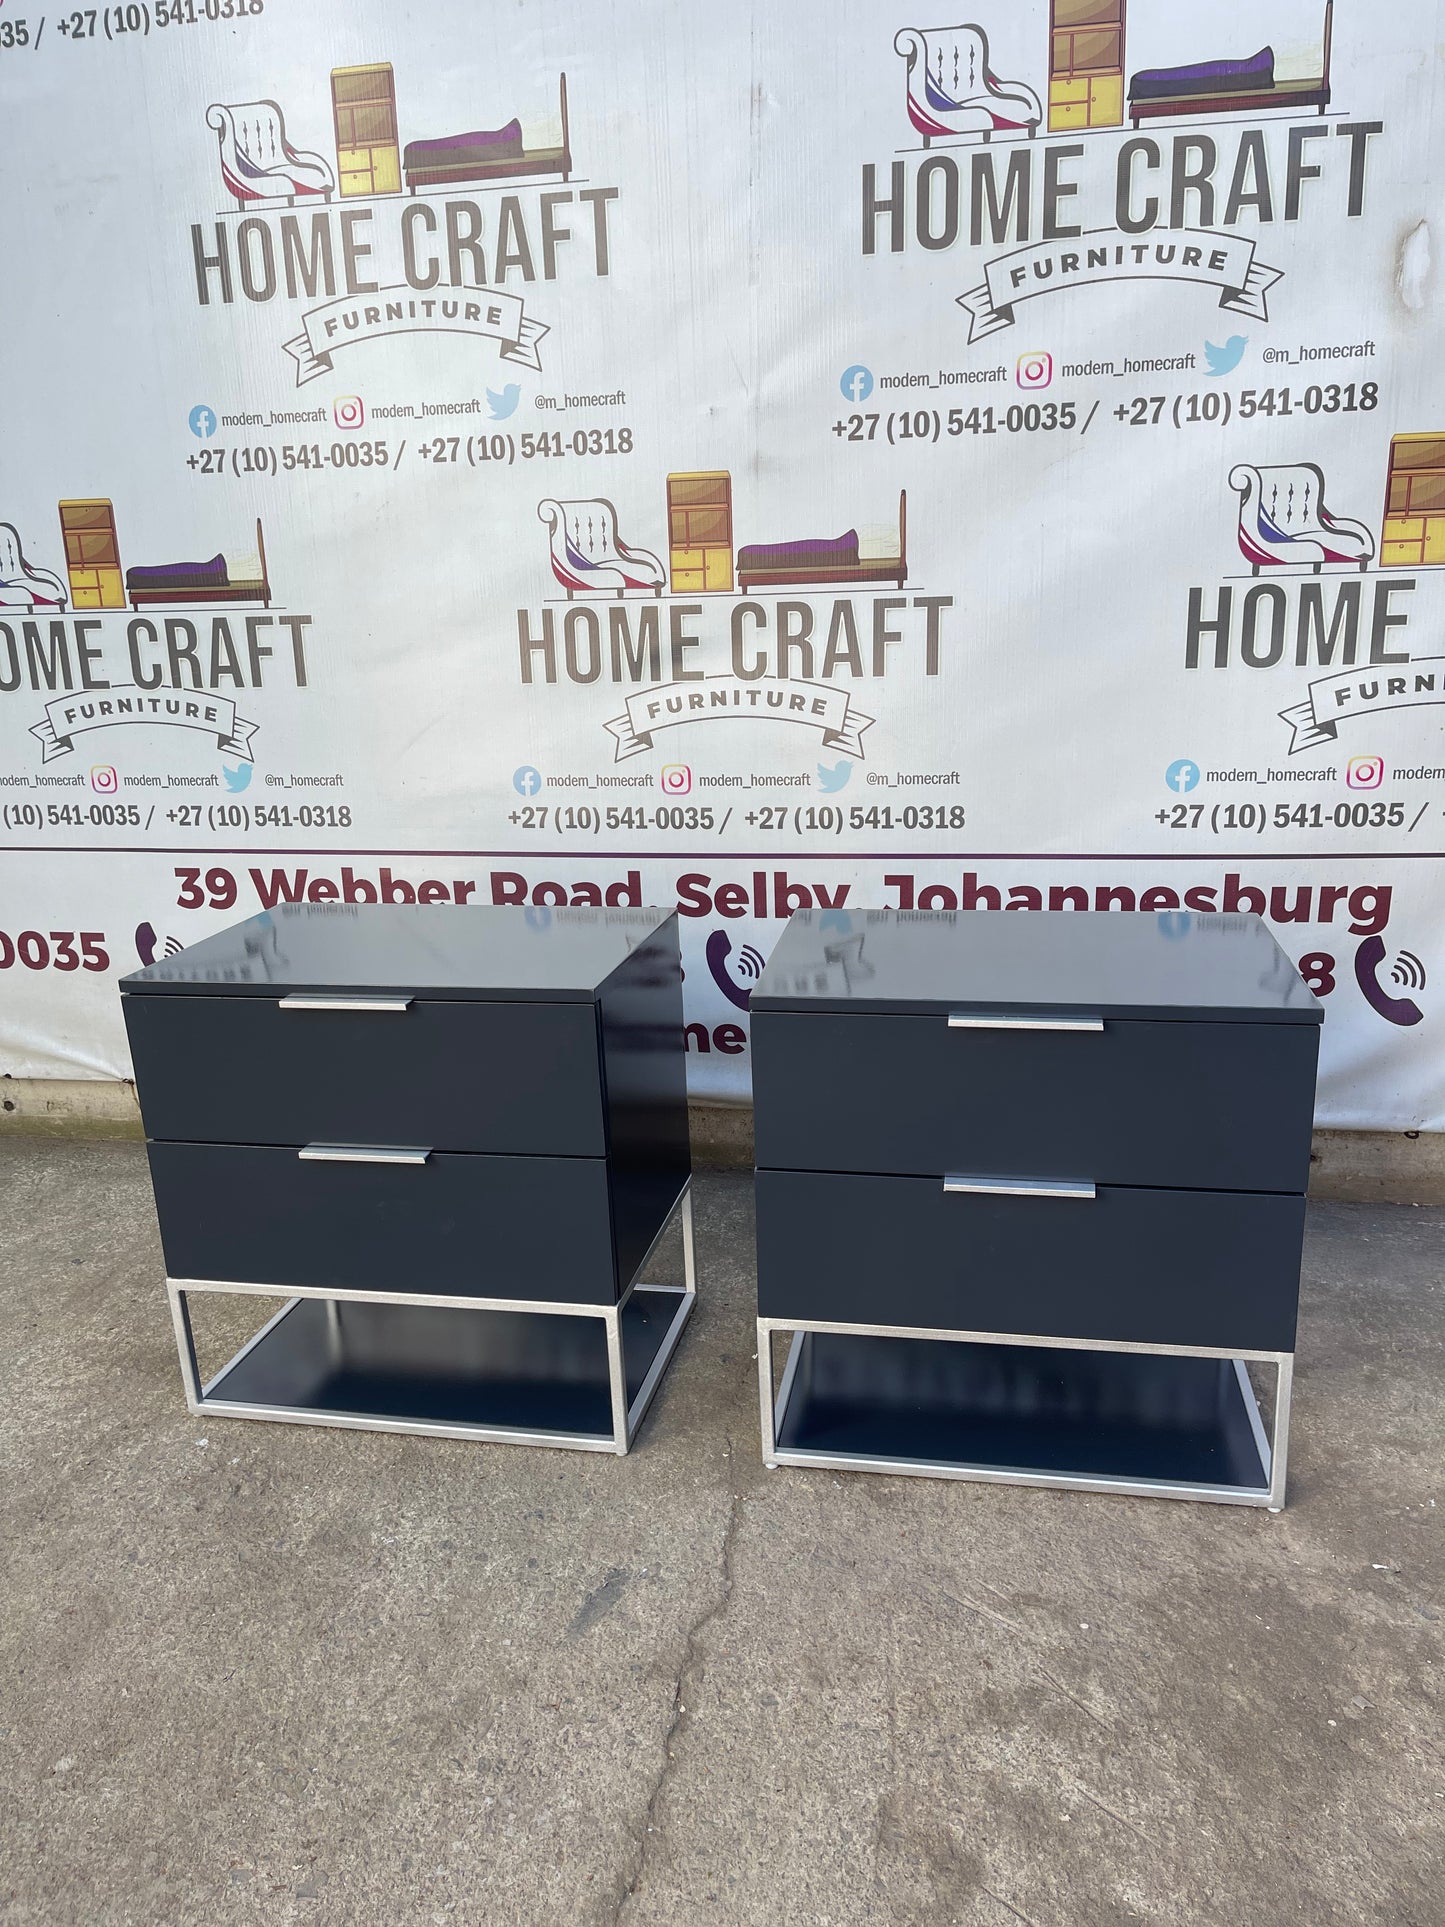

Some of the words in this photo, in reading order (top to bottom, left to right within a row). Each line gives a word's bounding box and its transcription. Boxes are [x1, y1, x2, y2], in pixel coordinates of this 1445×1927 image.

[34, 17, 45, 50] /
[57, 10, 97, 39] +27
[103, 3, 150, 40] (10)
[862, 144, 1084, 255] HOME
[1115, 121, 1383, 234] CRAFT
[190, 208, 379, 306] HOME
[400, 186, 619, 291] CRAFT
[1009, 244, 1229, 289] FURNITURE
[323, 299, 502, 338] FURNITURE
[1262, 341, 1375, 365] @m_homecraft
[534, 390, 626, 411] @m_homecraft
[832, 414, 880, 441] +27
[886, 410, 941, 445] (10)
[947, 402, 1076, 436] 541-0035
[1080, 400, 1100, 434] /
[1113, 397, 1166, 425] +27
[1172, 392, 1231, 429] (10)
[1238, 382, 1379, 419] 541-0318
[186, 448, 226, 474] +27
[232, 446, 277, 477] (10)
[282, 441, 389, 470] 541-0035
[393, 440, 406, 470] /
[418, 437, 460, 463] +27
[467, 434, 515, 466] (10)
[521, 427, 634, 459] 541-0318
[516, 604, 705, 684] HOME
[730, 596, 954, 681] CRAFT
[1185, 579, 1416, 669] HOME
[127, 615, 313, 691] CRAFT
[64, 697, 218, 724] FURNITURE
[647, 689, 828, 719] FURNITURE
[265, 774, 344, 788] @m_homecraft
[866, 771, 960, 787] @m_homecraft
[3, 804, 43, 830] (10)
[47, 804, 140, 826] 541-0035
[145, 805, 155, 830] /
[166, 805, 202, 826] +27
[208, 805, 250, 831] (10)
[254, 804, 352, 827] 541-0318
[508, 806, 549, 829] +27
[554, 806, 600, 834] (10)
[606, 806, 714, 830] 541-0035
[718, 807, 733, 835] /
[745, 807, 788, 829] +27
[794, 806, 843, 834] (10)
[849, 805, 965, 830] 541-0318
[1154, 804, 1204, 829] +27
[1211, 804, 1266, 834] (10)
[1273, 802, 1405, 828] 541-0035
[1407, 802, 1429, 832] /
[174, 867, 238, 911] 39
[248, 867, 475, 910] Webber
[490, 870, 660, 908] Road
[676, 871, 863, 919] Selby
[884, 872, 1393, 936] Johannesburg
